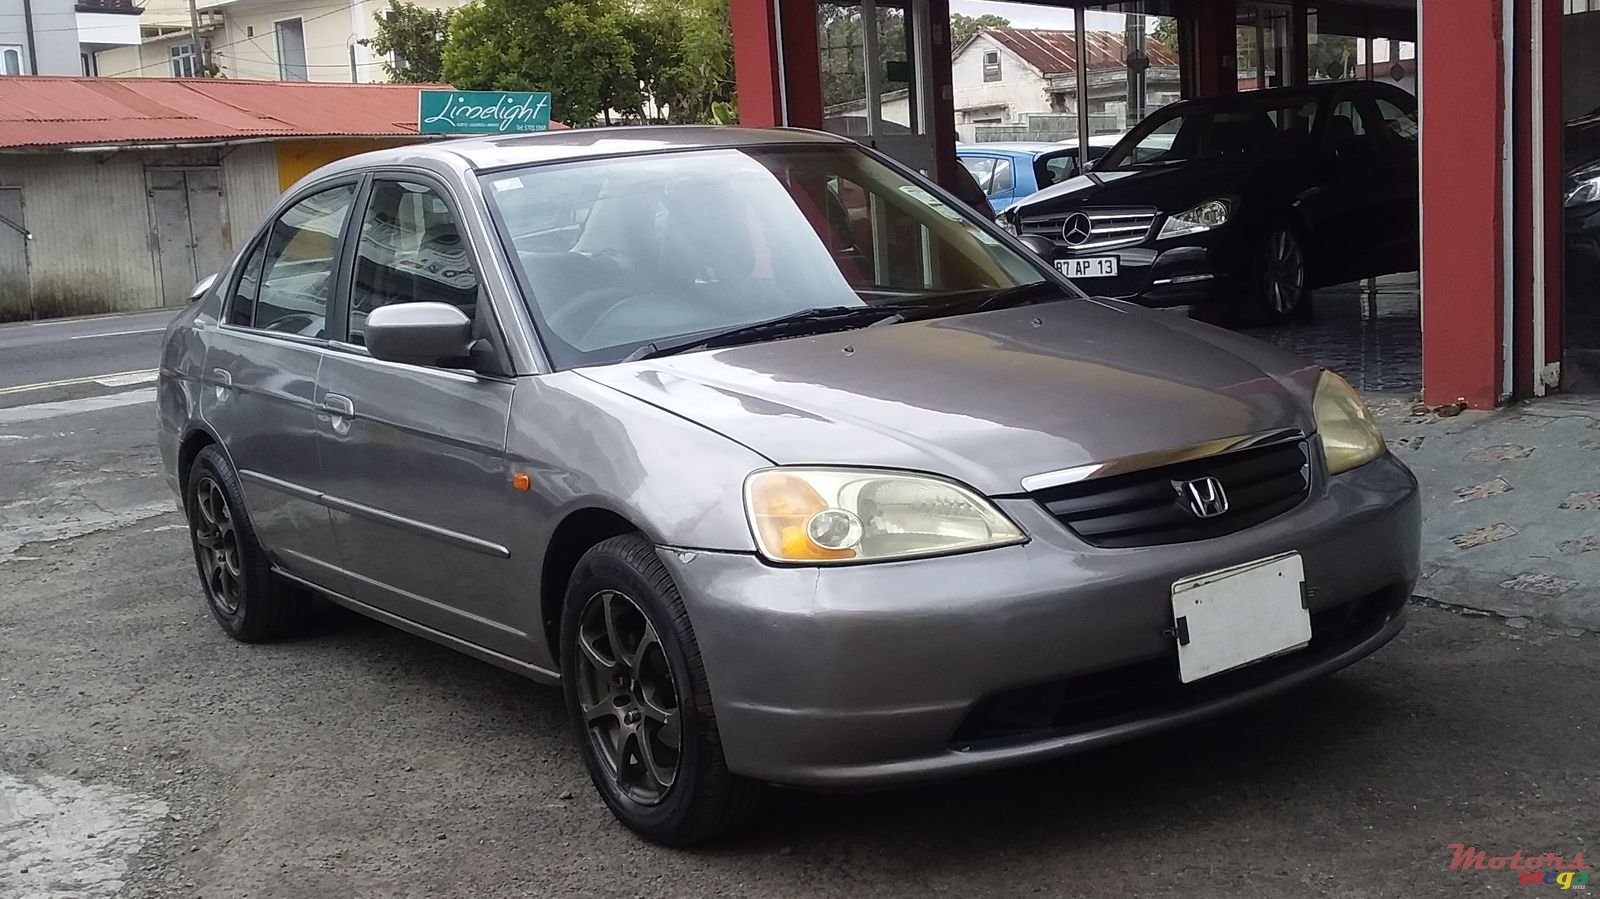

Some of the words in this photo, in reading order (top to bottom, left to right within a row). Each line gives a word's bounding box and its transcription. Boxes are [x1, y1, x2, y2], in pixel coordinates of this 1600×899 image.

[424, 94, 547, 131] Limelight
[1056, 261, 1070, 276] 87
[1076, 260, 1091, 276] AP
[1097, 260, 1113, 275] 13
